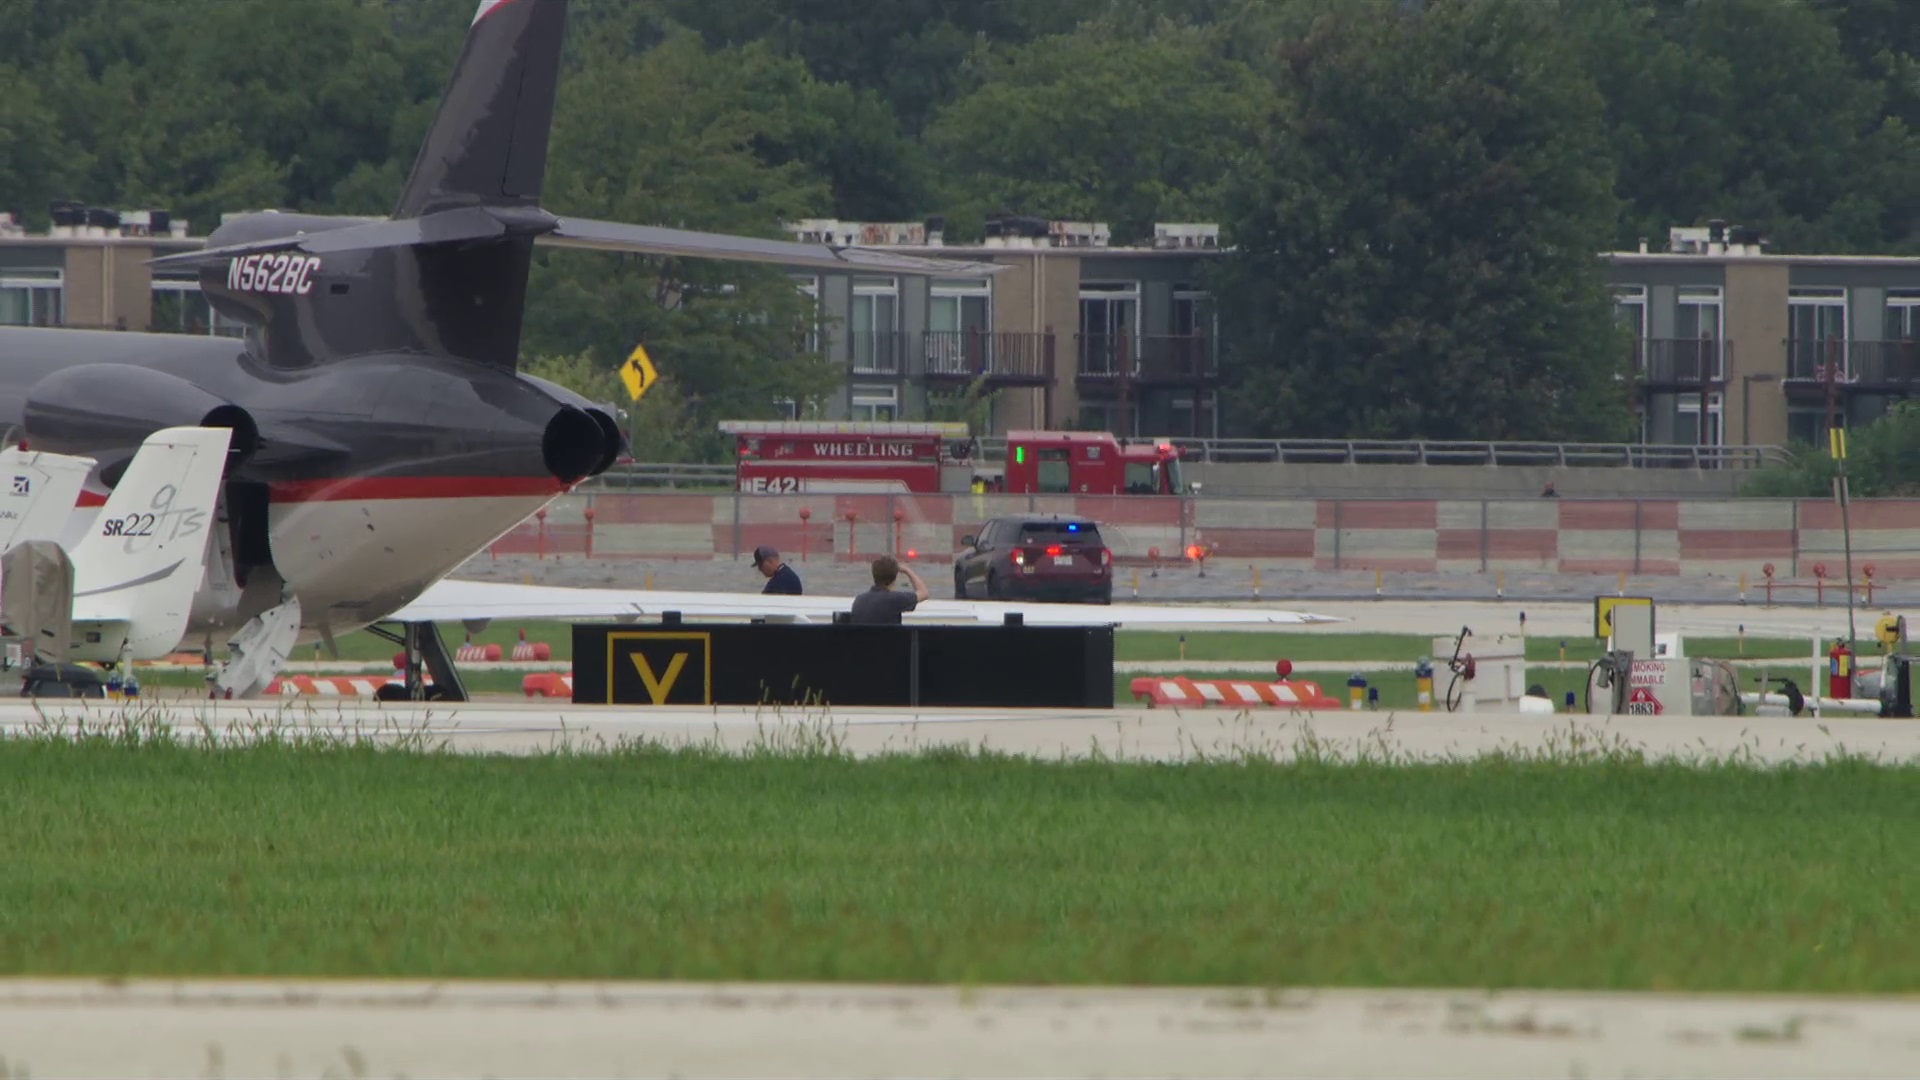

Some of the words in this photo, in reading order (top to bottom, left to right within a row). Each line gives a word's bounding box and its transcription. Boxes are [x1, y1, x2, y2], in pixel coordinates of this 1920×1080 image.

[227, 254, 321, 294] N562BC
[813, 442, 913, 457] WHEELING
[752, 476, 797, 494] E42
[103, 513, 156, 536] SR22
[1632, 661, 1665, 672] MOKING
[629, 652, 689, 705] V
